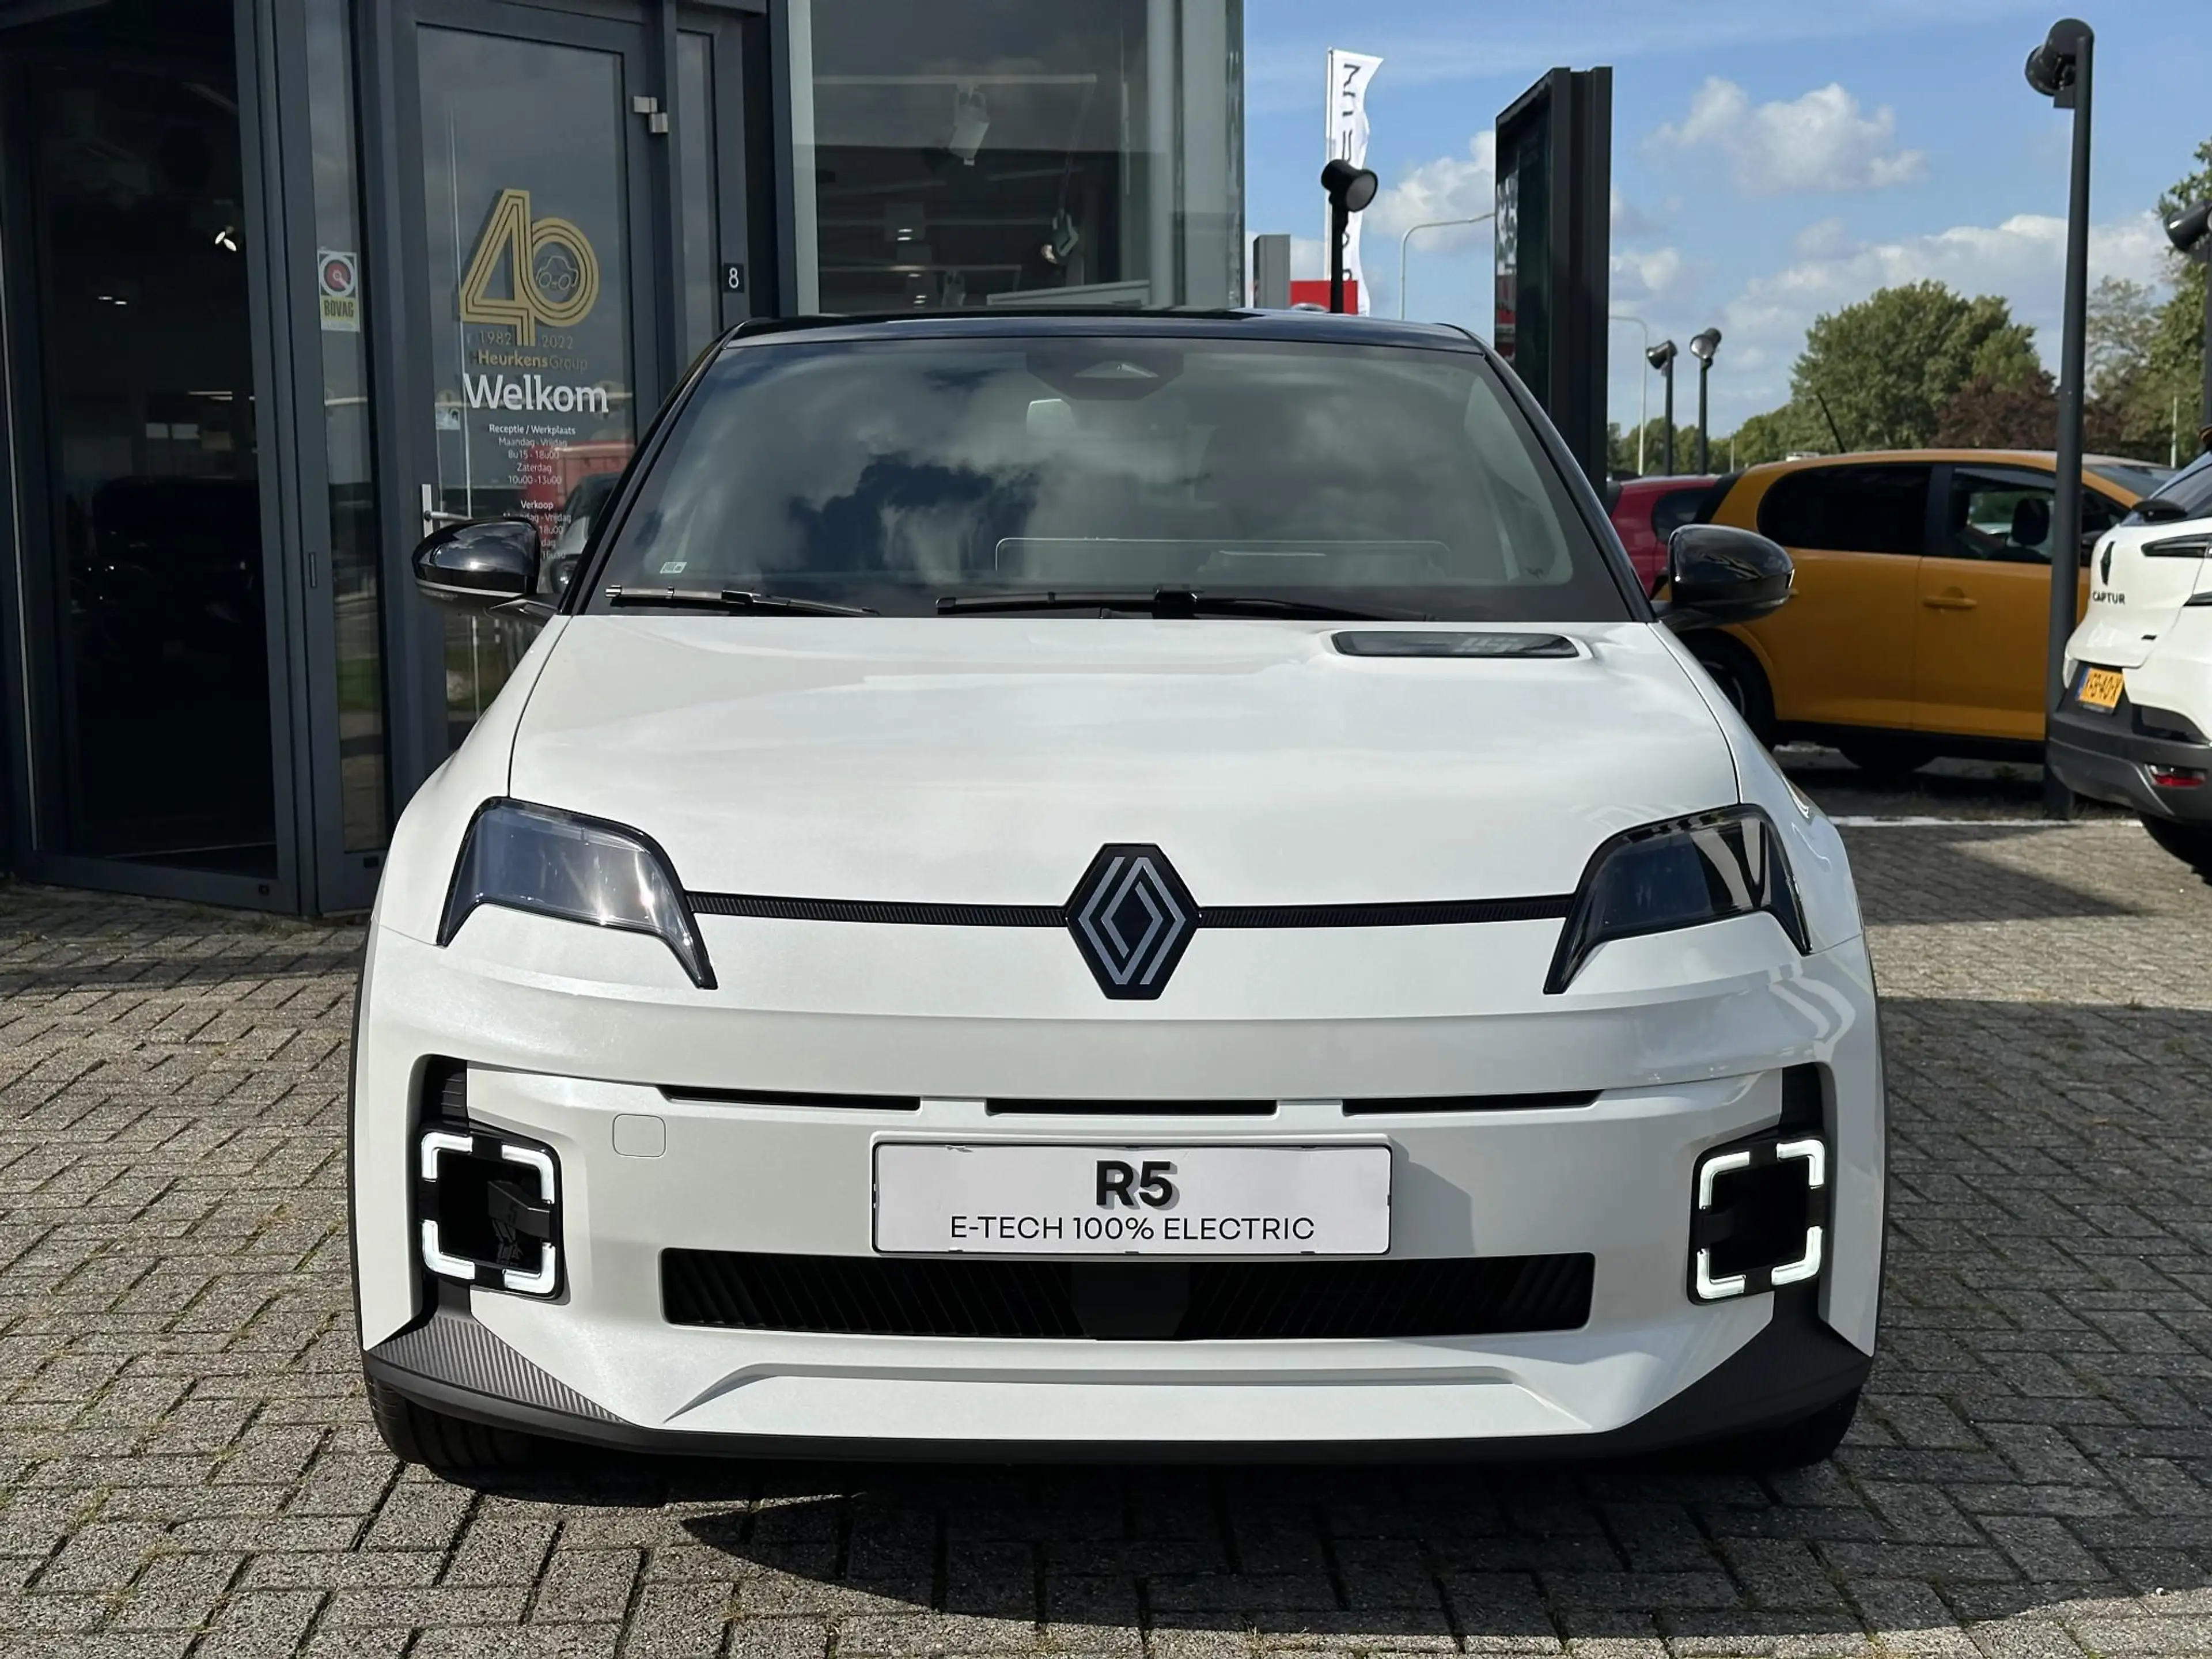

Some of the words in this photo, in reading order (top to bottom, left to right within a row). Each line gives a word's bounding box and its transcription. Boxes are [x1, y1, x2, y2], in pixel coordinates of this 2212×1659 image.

[460, 188, 599, 346] 40
[729, 267, 738, 289] 8
[324, 300, 354, 318] BOVAG
[479, 330, 512, 345] 1982
[541, 334, 574, 349] 2022
[463, 373, 609, 412] Welkom
[489, 424, 524, 433] Receptie
[531, 426, 576, 436] Werkplaats
[498, 436, 535, 448] Maandag
[540, 438, 567, 449] Vrijdag
[508, 450, 528, 459] 8u15
[535, 451, 559, 460] 18u00
[517, 462, 552, 472] Zaterdag
[521, 500, 554, 511] Verkoop
[544, 513, 571, 524] Vrijdag
[539, 525, 564, 535] 18u00
[2093, 591, 2126, 605] CAPTUR
[1096, 1160, 1173, 1207] R5
[951, 1215, 1063, 1240] E-TECH
[1073, 1217, 1154, 1240] 100%
[1164, 1217, 1315, 1240] ELECTRIC
